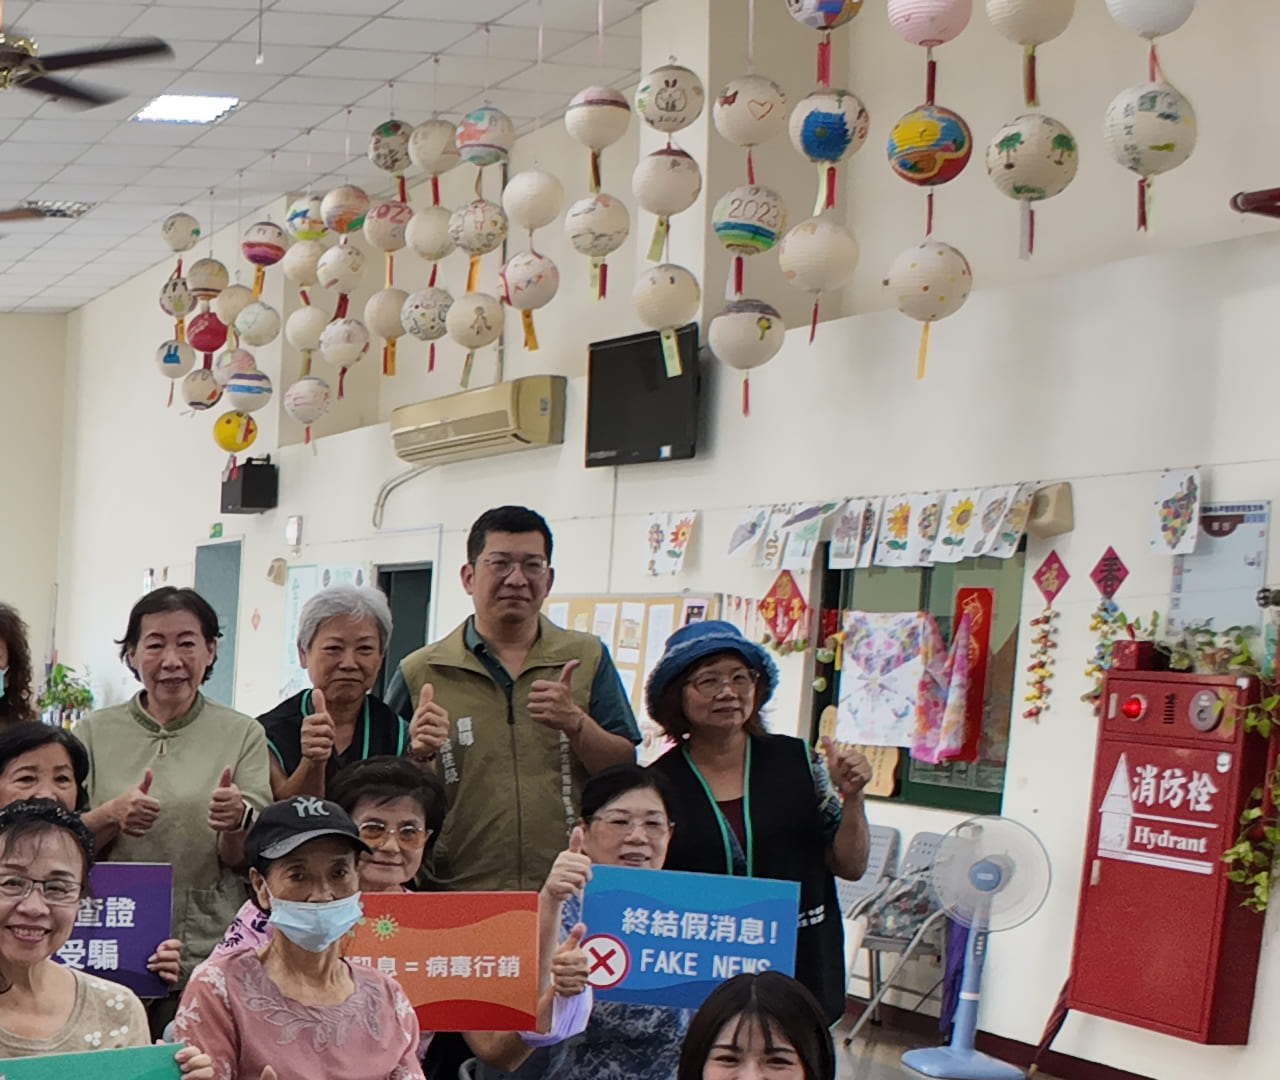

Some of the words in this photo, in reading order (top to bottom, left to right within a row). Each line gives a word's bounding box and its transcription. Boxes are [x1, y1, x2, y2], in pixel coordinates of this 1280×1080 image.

[1132, 765, 1219, 813] 消防栓
[1134, 824, 1208, 855] Hydrant
[74, 896, 136, 928] 查證
[56, 939, 119, 970] 受騙
[425, 955, 521, 978] 病毒行銷
[640, 948, 699, 976] FAKE
[711, 954, 772, 979] NEWS
